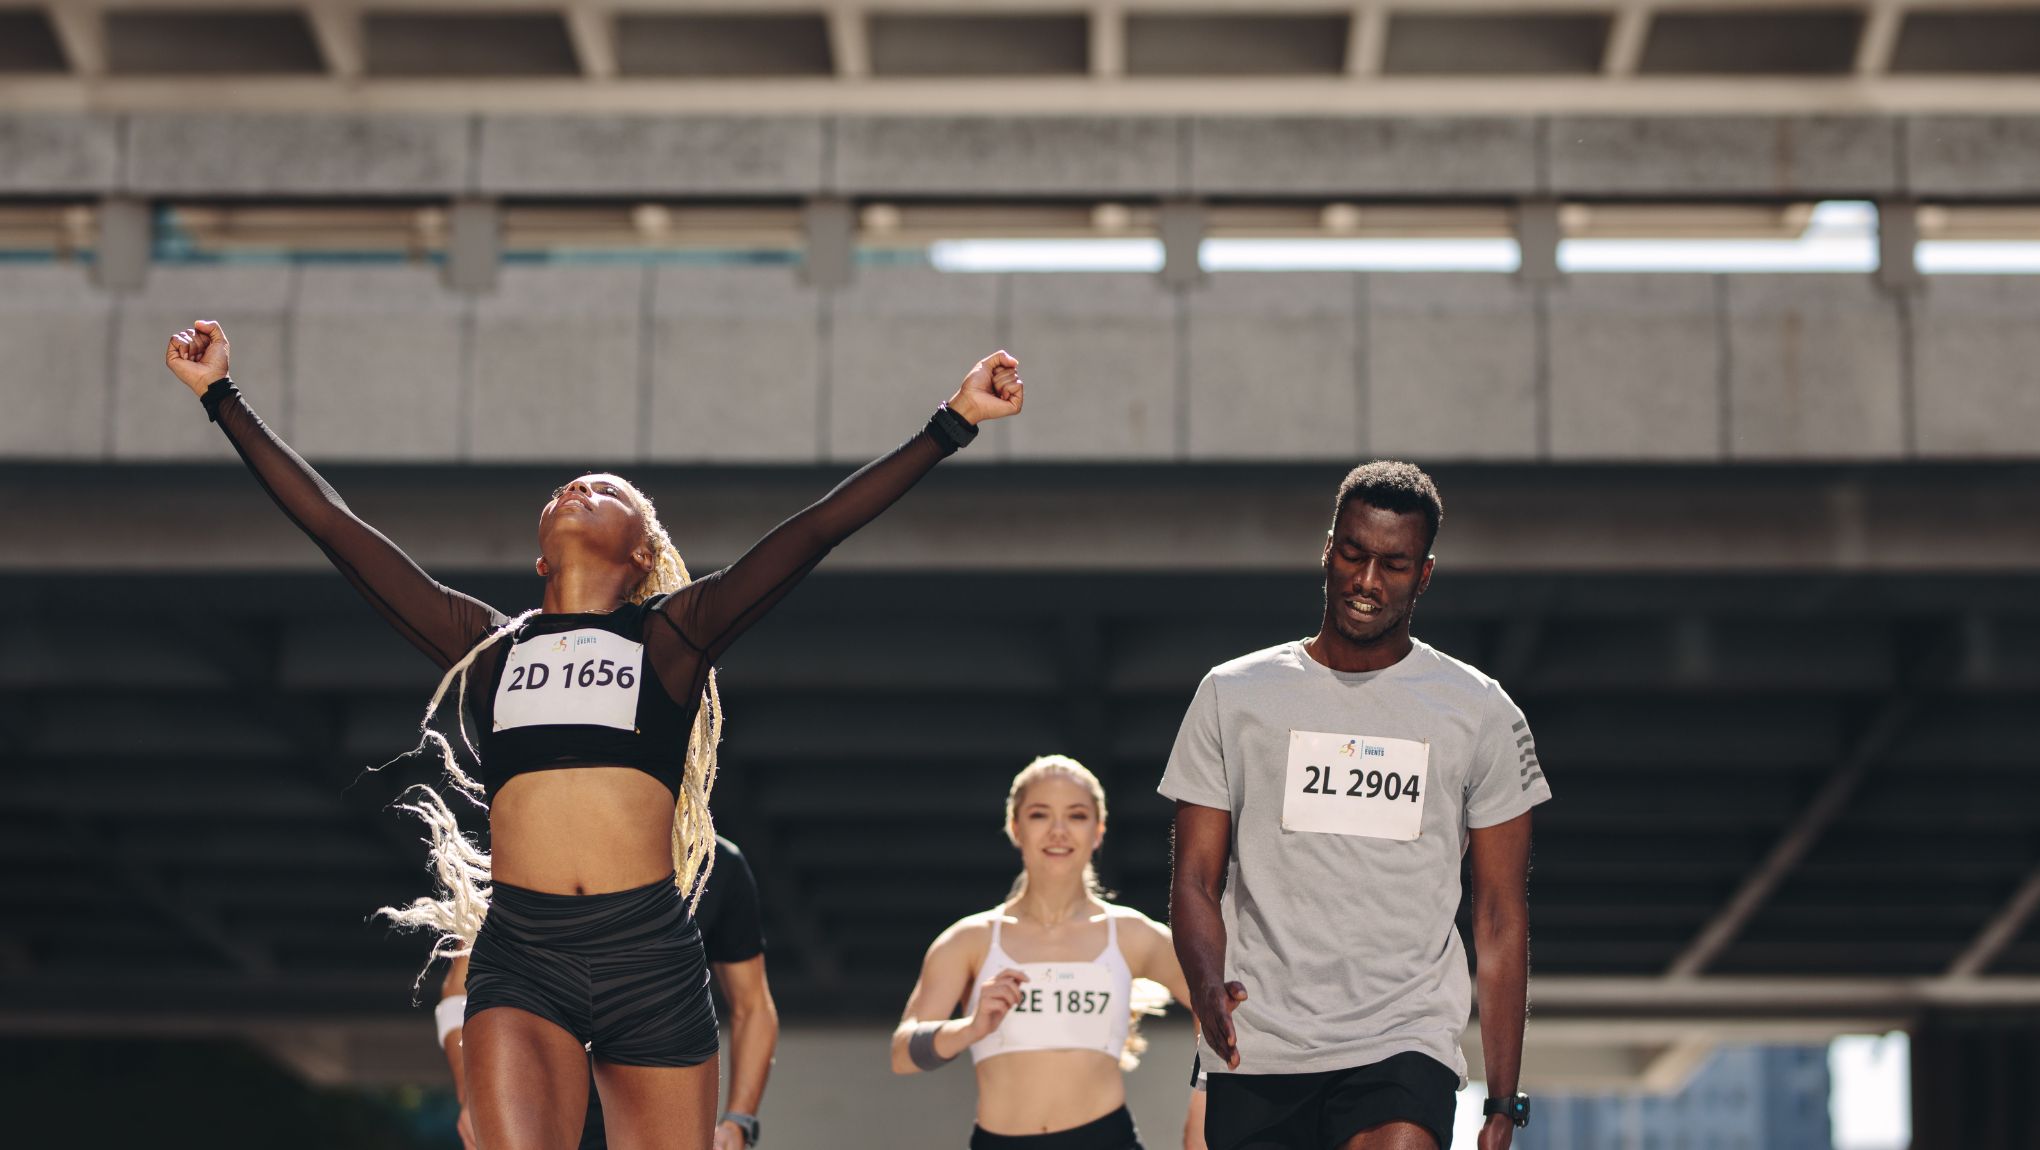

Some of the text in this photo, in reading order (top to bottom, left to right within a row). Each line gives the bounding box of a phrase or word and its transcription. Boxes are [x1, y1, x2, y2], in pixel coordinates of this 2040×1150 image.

[507, 659, 635, 692] 2D 1656
[1364, 748, 1385, 757] EVENTS
[1302, 765, 1420, 803] 2L 2904
[1014, 989, 1111, 1014] 2E 1857
